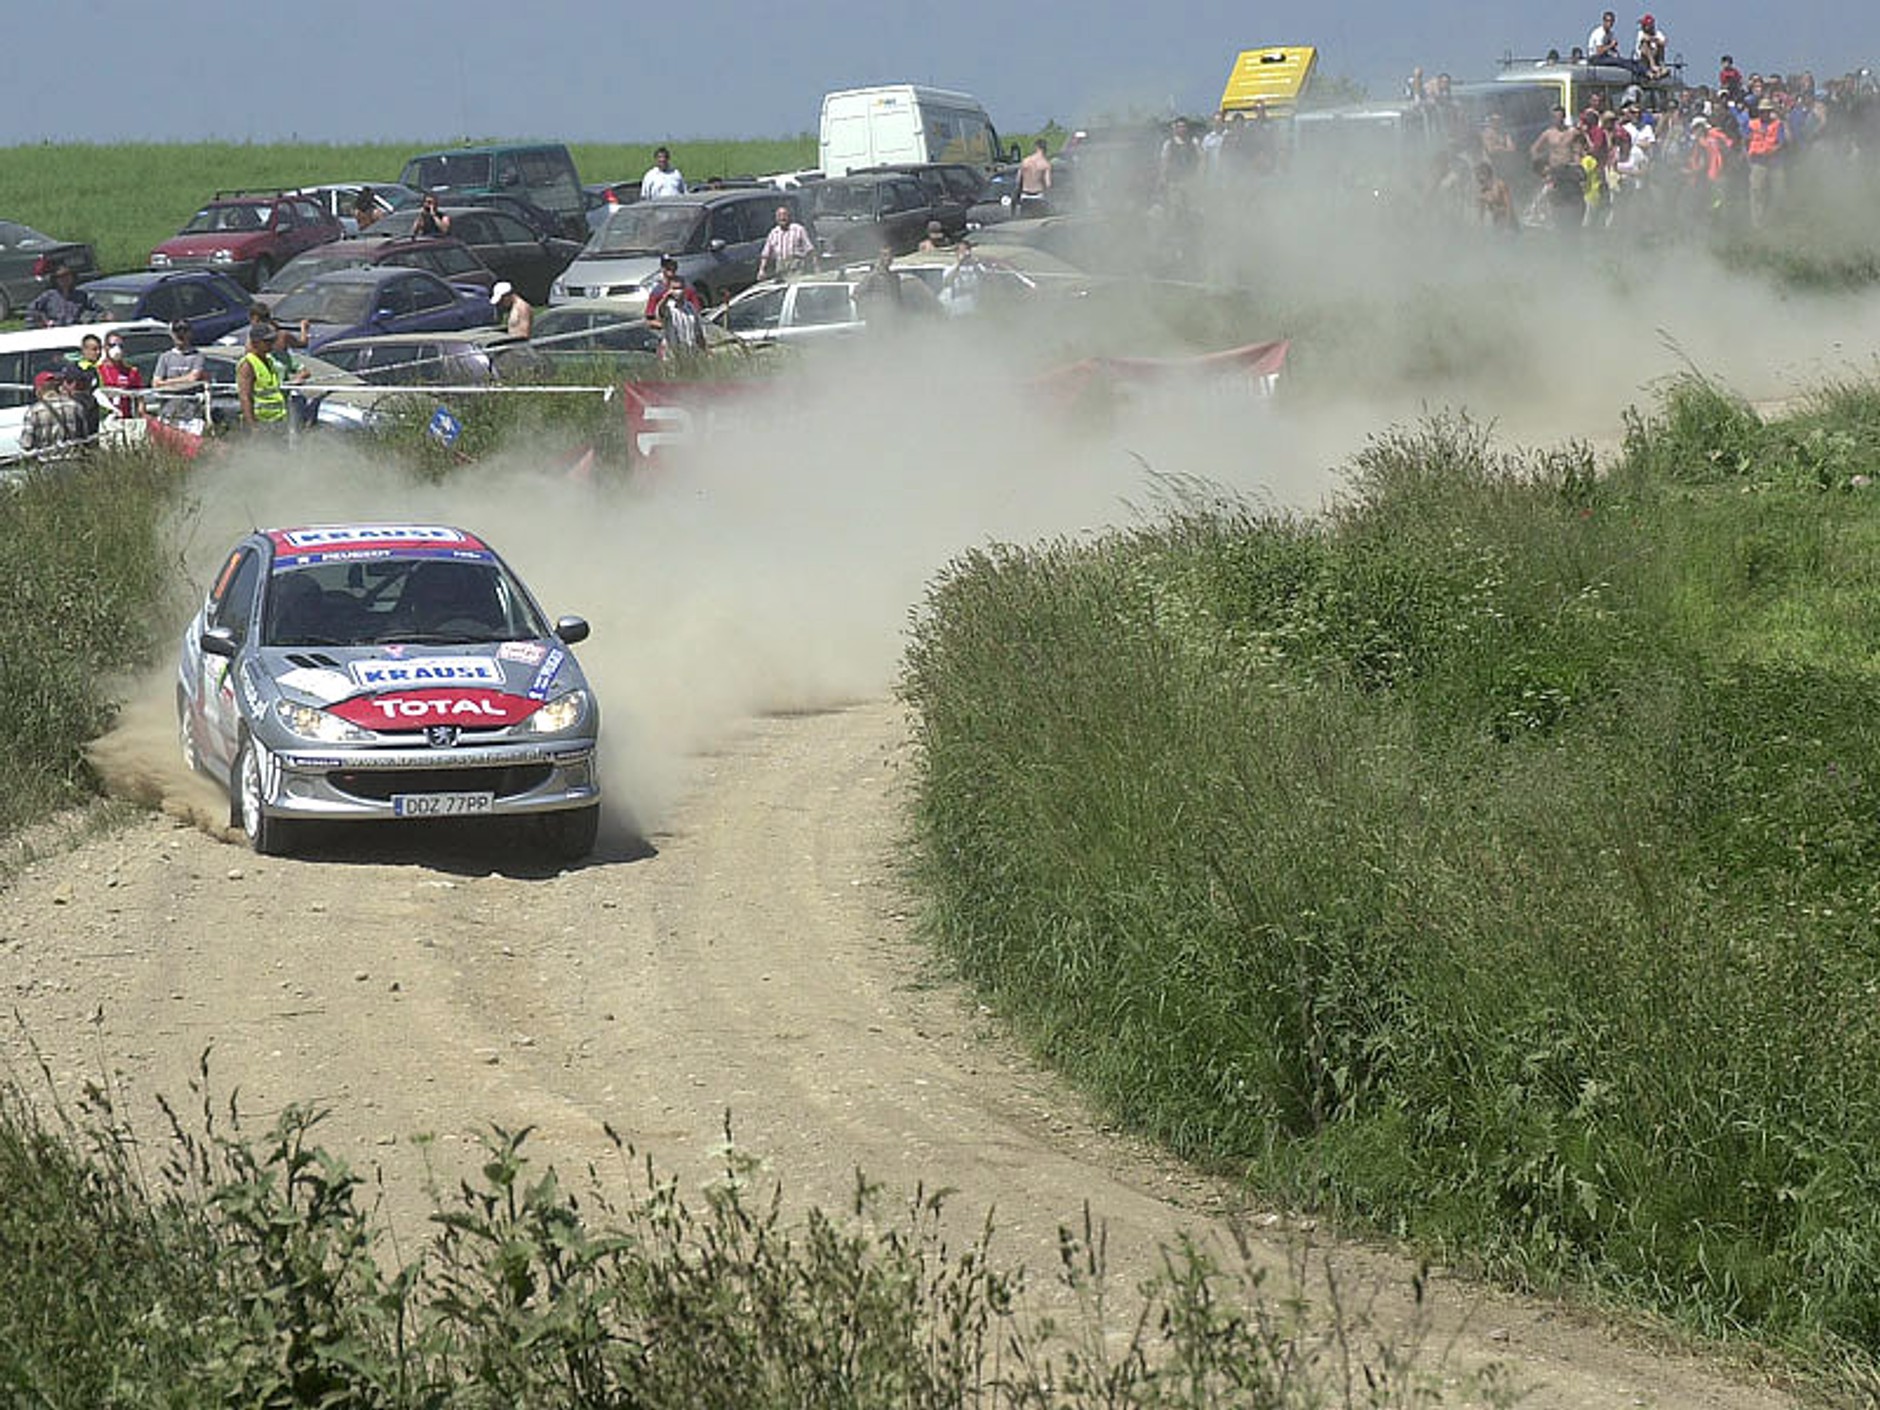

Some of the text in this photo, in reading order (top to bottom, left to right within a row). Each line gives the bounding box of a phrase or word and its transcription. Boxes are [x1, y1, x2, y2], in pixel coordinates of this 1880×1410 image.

[300, 530, 450, 541] KRAUSE
[365, 666, 493, 683] KRAUSE
[373, 698, 507, 718] TOTAL
[446, 796, 488, 812] 77PP
